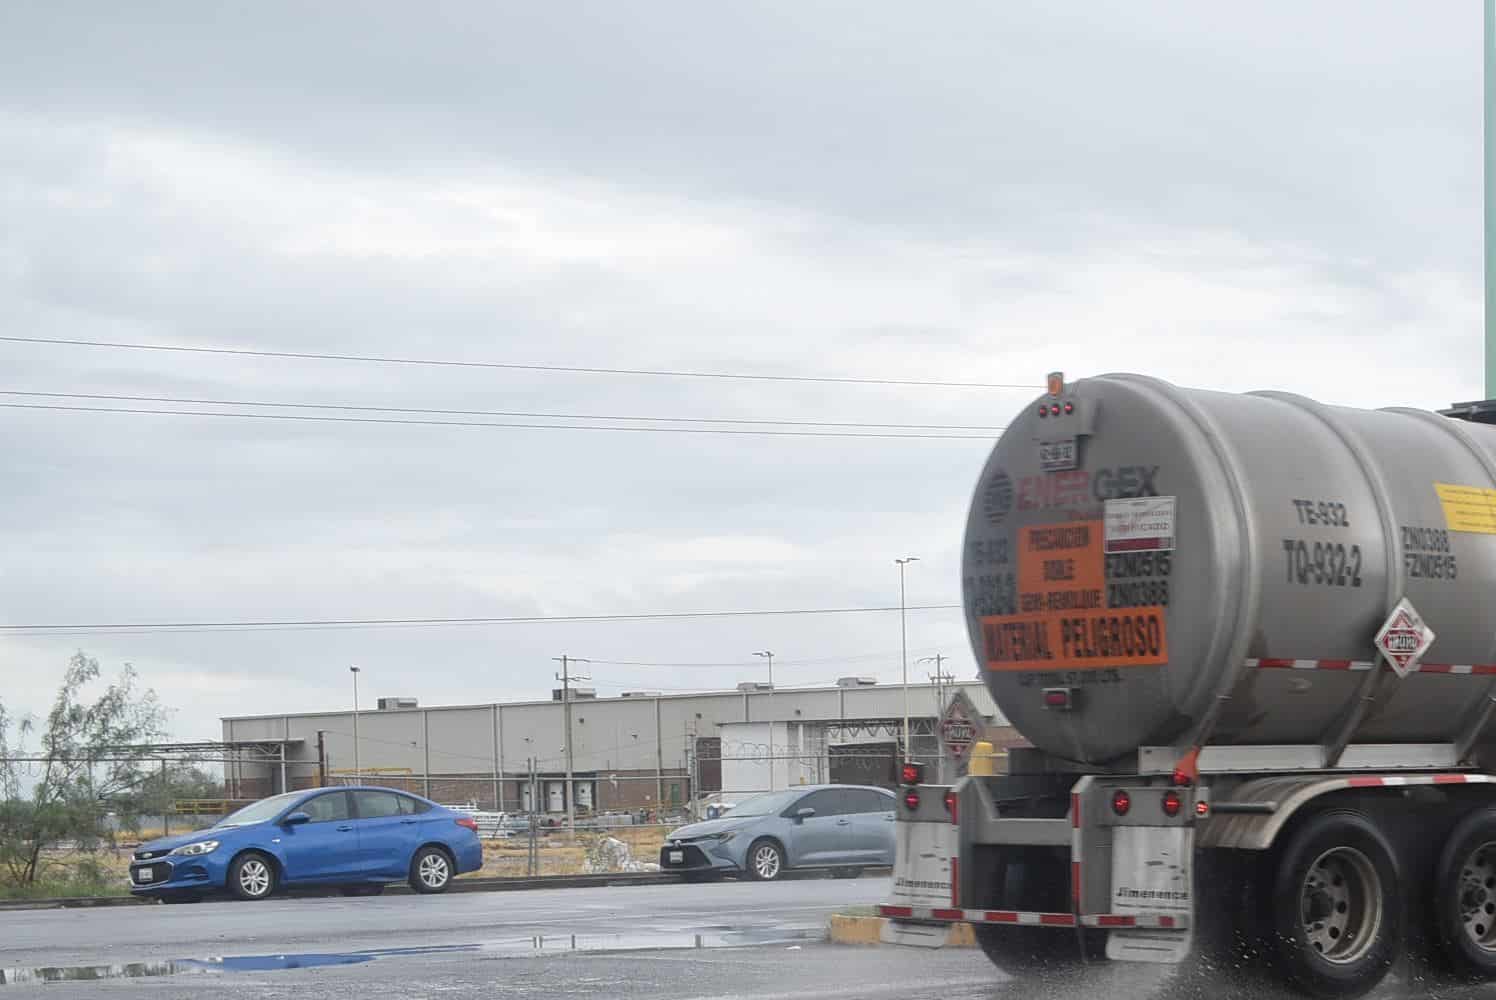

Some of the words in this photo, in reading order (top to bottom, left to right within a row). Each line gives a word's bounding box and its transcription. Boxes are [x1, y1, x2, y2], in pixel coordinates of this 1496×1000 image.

[1292, 499, 1350, 528] TE-932
[984, 619, 1053, 662] MATERIAL
[1062, 614, 1160, 658] PELIGROSO
